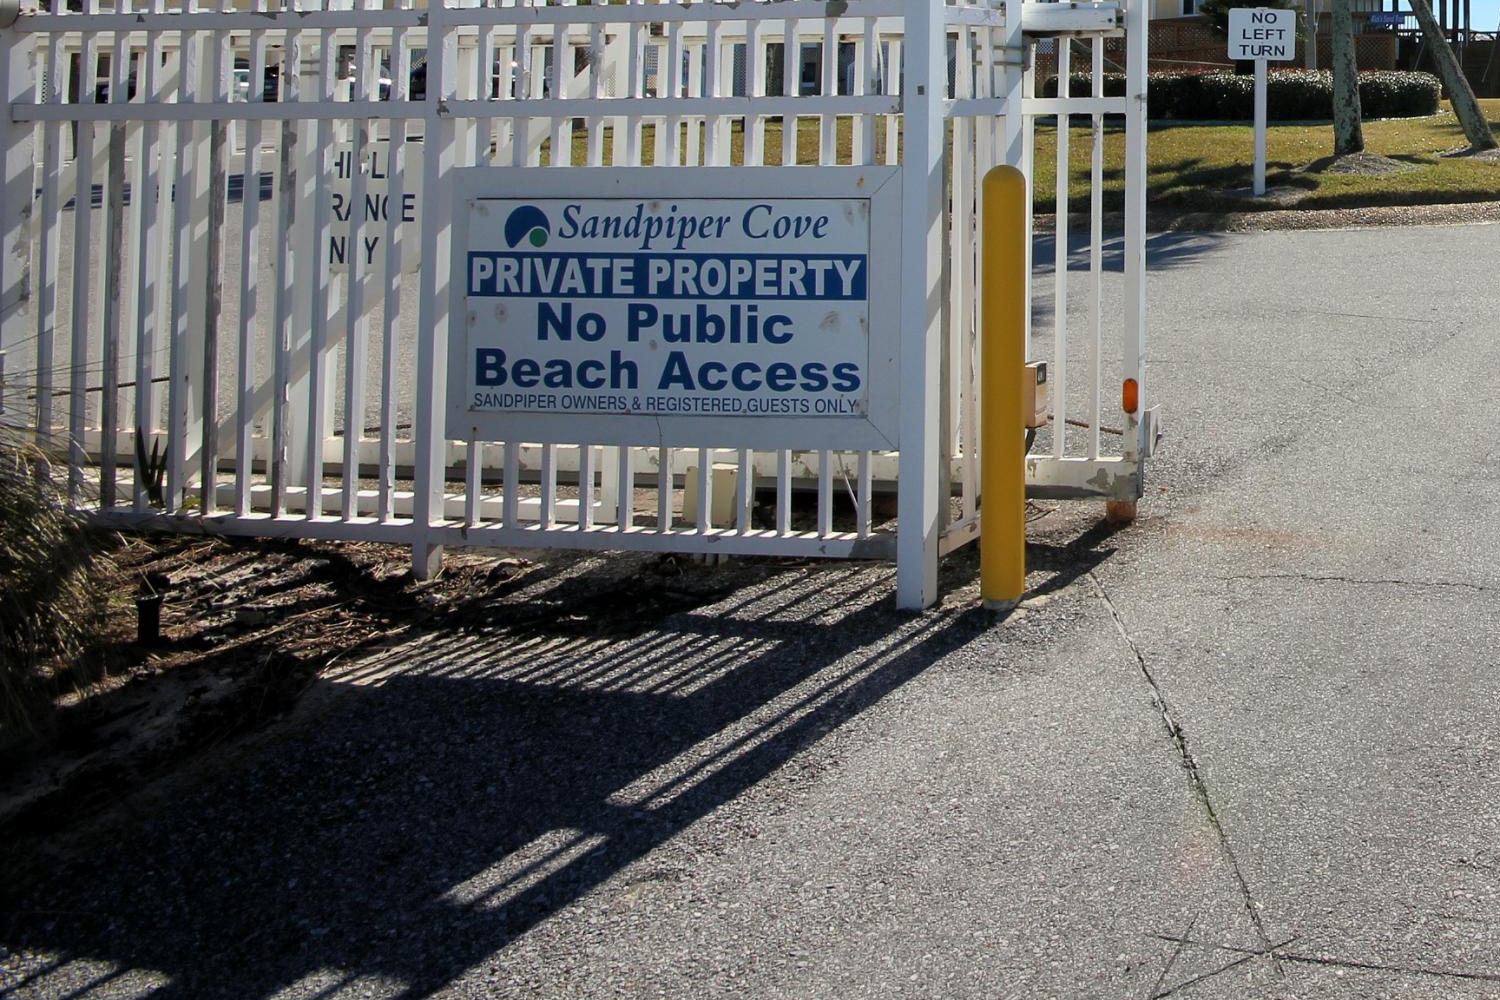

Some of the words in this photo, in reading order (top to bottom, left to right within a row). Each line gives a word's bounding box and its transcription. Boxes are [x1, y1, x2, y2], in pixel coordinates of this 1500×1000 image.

[1251, 12, 1277, 24] NO
[1242, 28, 1286, 40] LEFT
[1239, 44, 1285, 56] TURN
[558, 203, 731, 250] Sandpiper
[742, 203, 829, 240] Cove
[472, 256, 635, 294] PRIVATE
[648, 258, 862, 297] PROPERTY
[537, 302, 607, 342] No
[627, 303, 794, 344] Public
[475, 348, 638, 389] Beach
[657, 351, 861, 392] Access
[474, 393, 557, 408] SANDPIPER
[561, 394, 627, 410] OWNERS
[631, 396, 641, 410] &
[646, 397, 743, 412] REGISTERED
[747, 398, 810, 413] GUESTS
[815, 399, 857, 414] ONLY
